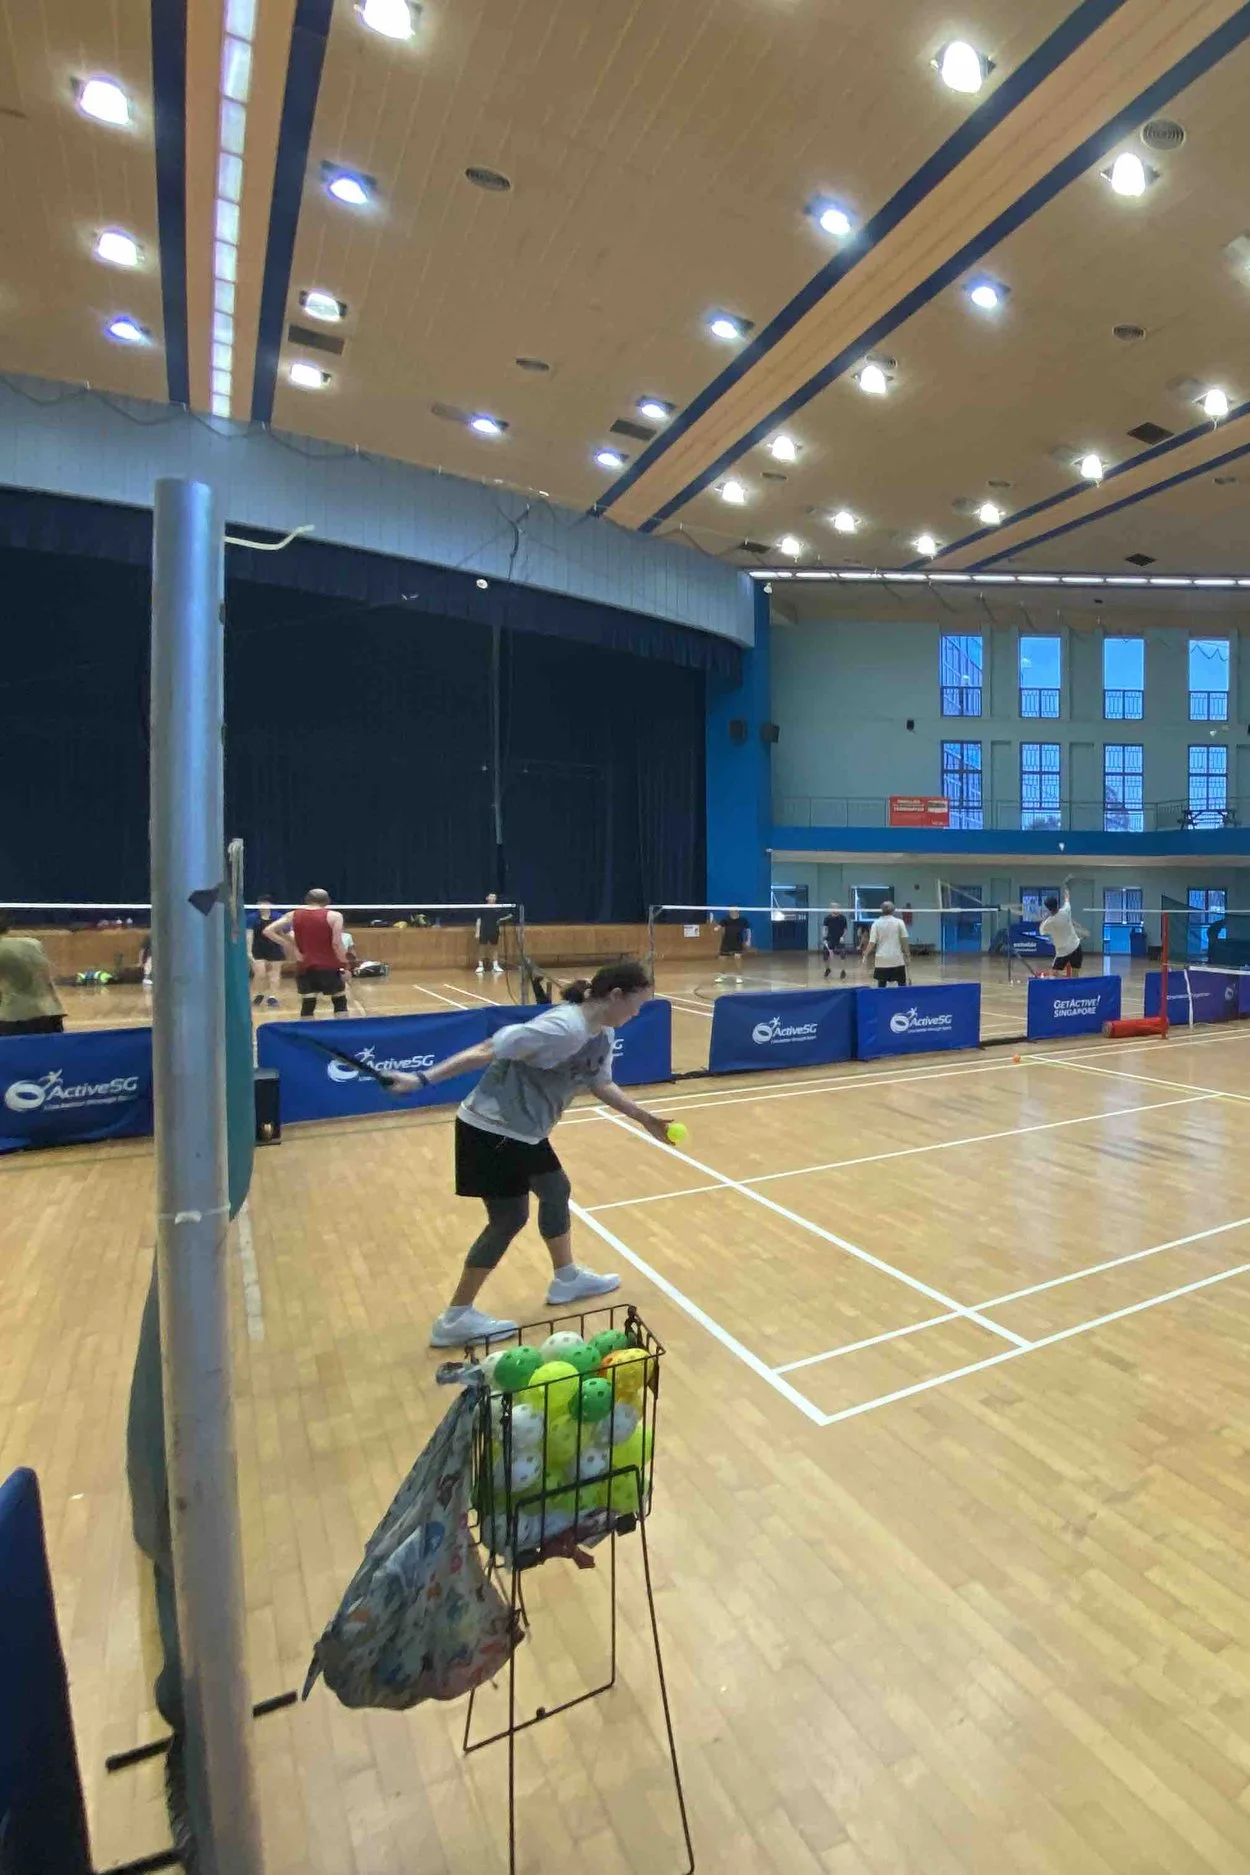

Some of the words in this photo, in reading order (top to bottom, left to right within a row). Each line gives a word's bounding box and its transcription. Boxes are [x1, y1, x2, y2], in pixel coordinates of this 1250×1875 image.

[1053, 1007, 1097, 1018] SINGAPORE
[909, 1014, 953, 1028] ActiveSG
[772, 1023, 818, 1037] ActiveSG
[46, 1076, 139, 1101] ActiveSG
